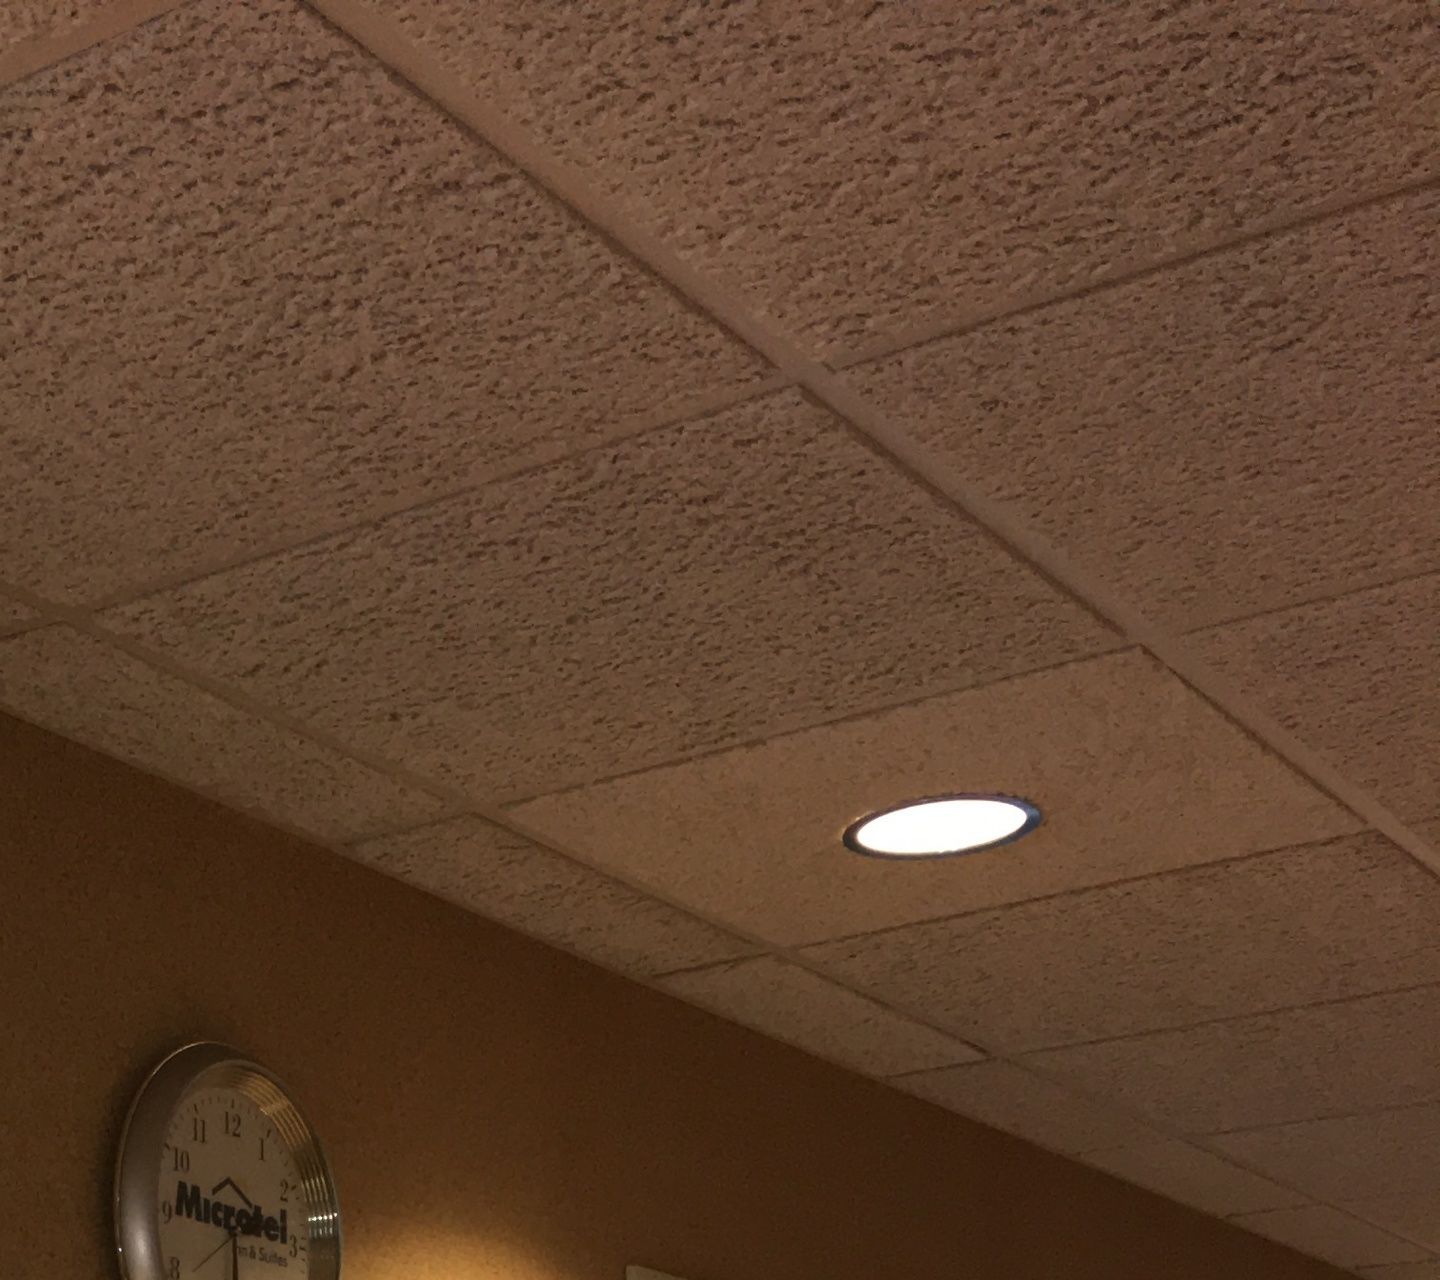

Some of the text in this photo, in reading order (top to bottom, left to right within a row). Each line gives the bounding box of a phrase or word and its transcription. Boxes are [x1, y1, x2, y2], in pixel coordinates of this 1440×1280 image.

[192, 1116, 208, 1144] 11
[223, 1111, 241, 1138] 12
[172, 1147, 190, 1172] 10
[258, 1138, 265, 1161] 1
[279, 1180, 289, 1203] 2
[162, 1200, 172, 1224] 9
[258, 1247, 289, 1268] Suites
[289, 1234, 298, 1259] 3
